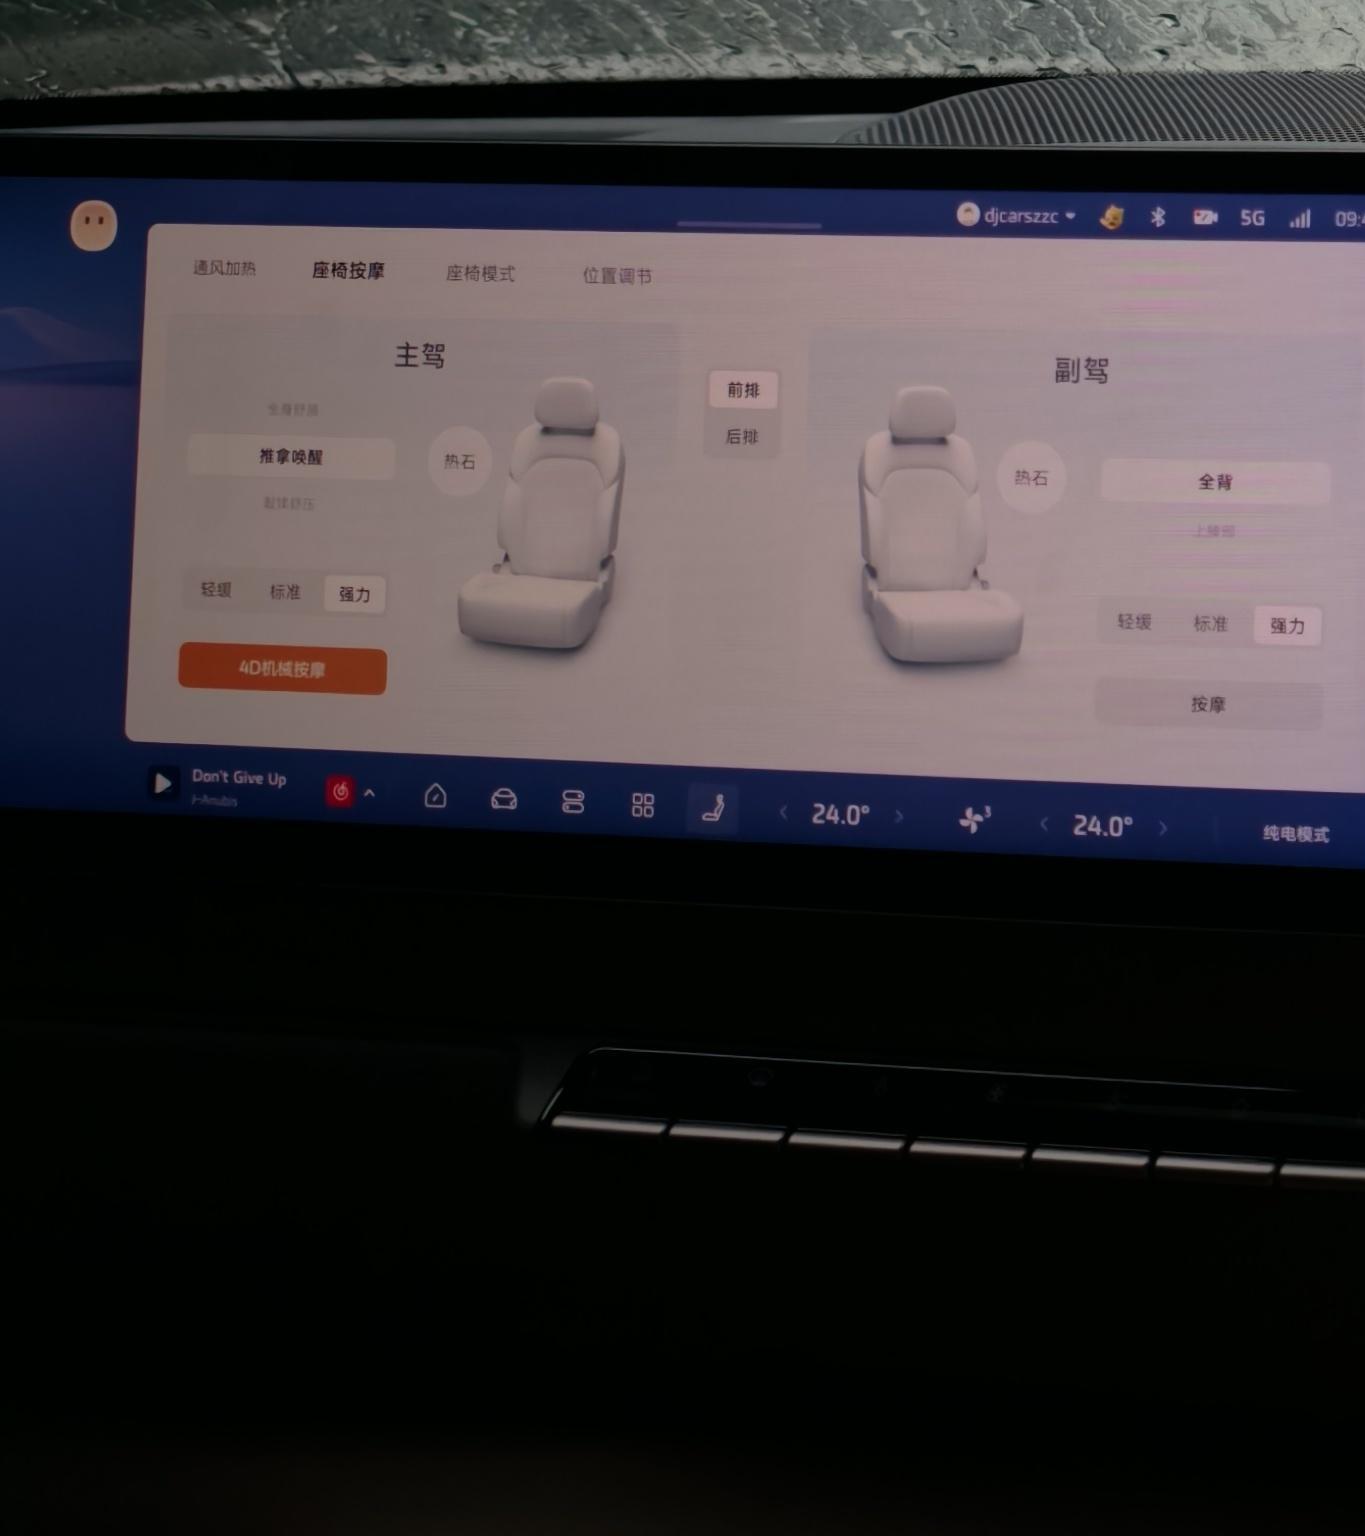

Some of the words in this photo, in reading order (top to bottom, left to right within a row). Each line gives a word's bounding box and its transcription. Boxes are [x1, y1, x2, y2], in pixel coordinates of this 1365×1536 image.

[984, 205, 1059, 227] djcarszzc
[1240, 209, 1265, 227] 5G
[192, 259, 257, 278] 通风加热
[312, 260, 386, 282] 座椅按摩
[446, 263, 516, 285] 座椅模式
[583, 266, 653, 286] 位置调节
[395, 341, 446, 369] 主驾
[1054, 357, 1110, 385] 副驾
[727, 381, 760, 400] 前排
[726, 427, 759, 446] 后排
[259, 448, 324, 466] 推拿唤醒
[444, 453, 476, 471] 热石
[1014, 468, 1049, 488] 热石
[1199, 473, 1233, 492] 全背
[270, 583, 301, 601] 标准
[339, 586, 371, 604] 强力
[1117, 612, 1152, 632] 轻缓
[1194, 614, 1229, 634] 标准
[1270, 616, 1305, 636] 强力
[239, 659, 326, 679] 4D机械按摩
[1192, 695, 1226, 714] 按摩
[192, 768, 229, 783] Don't
[233, 770, 264, 785] Give
[268, 772, 287, 788] Up
[1263, 825, 1330, 844] 纯电模式
